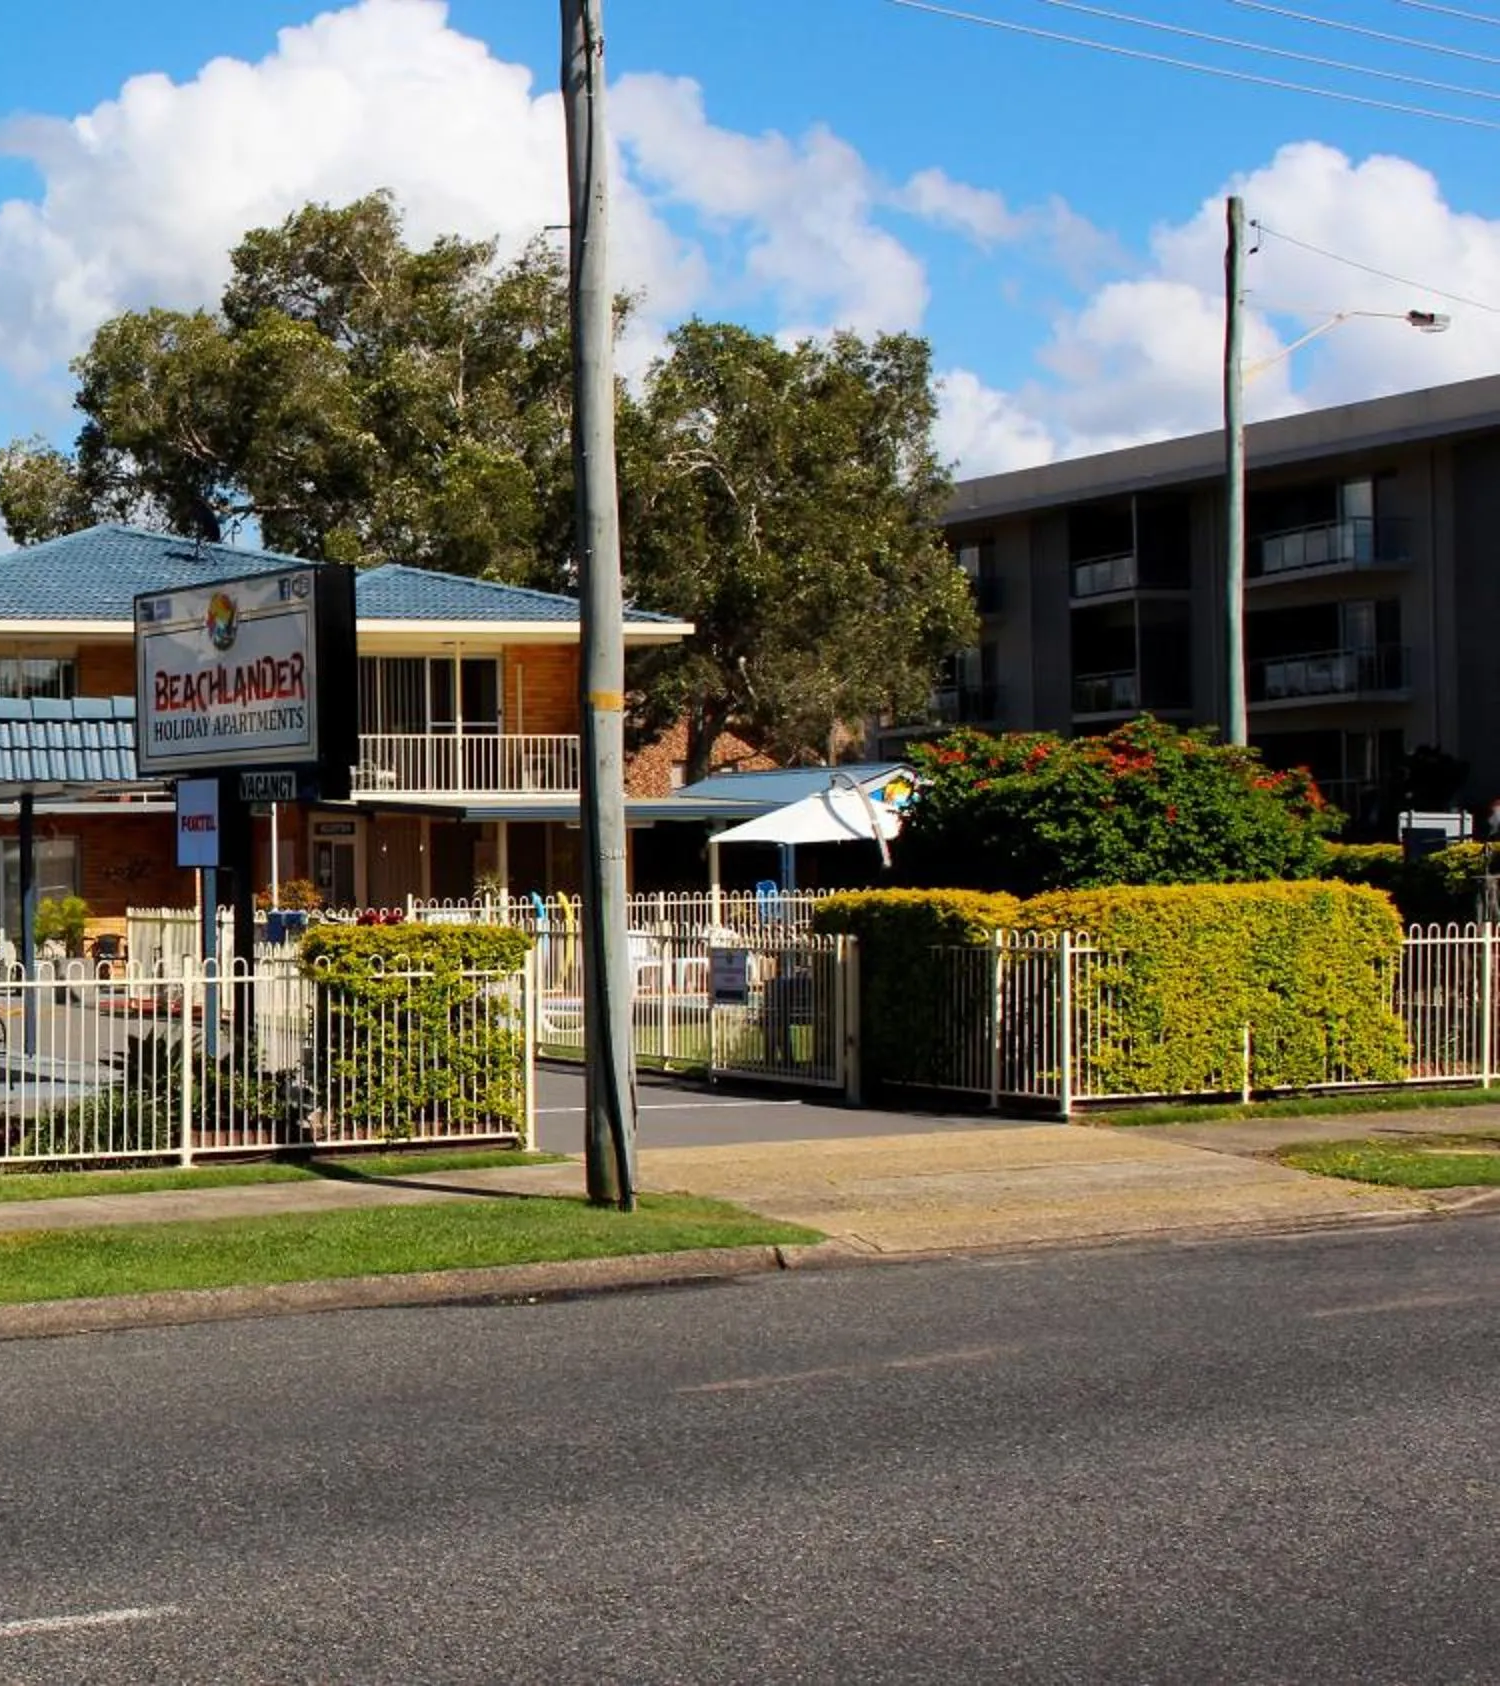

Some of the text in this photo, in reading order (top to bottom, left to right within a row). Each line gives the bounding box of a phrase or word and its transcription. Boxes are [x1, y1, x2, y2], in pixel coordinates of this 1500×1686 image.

[155, 652, 306, 713] BEACHLANDER
[154, 706, 305, 743] HOLIDAY APARTMENTS
[241, 774, 292, 800] VACANCY
